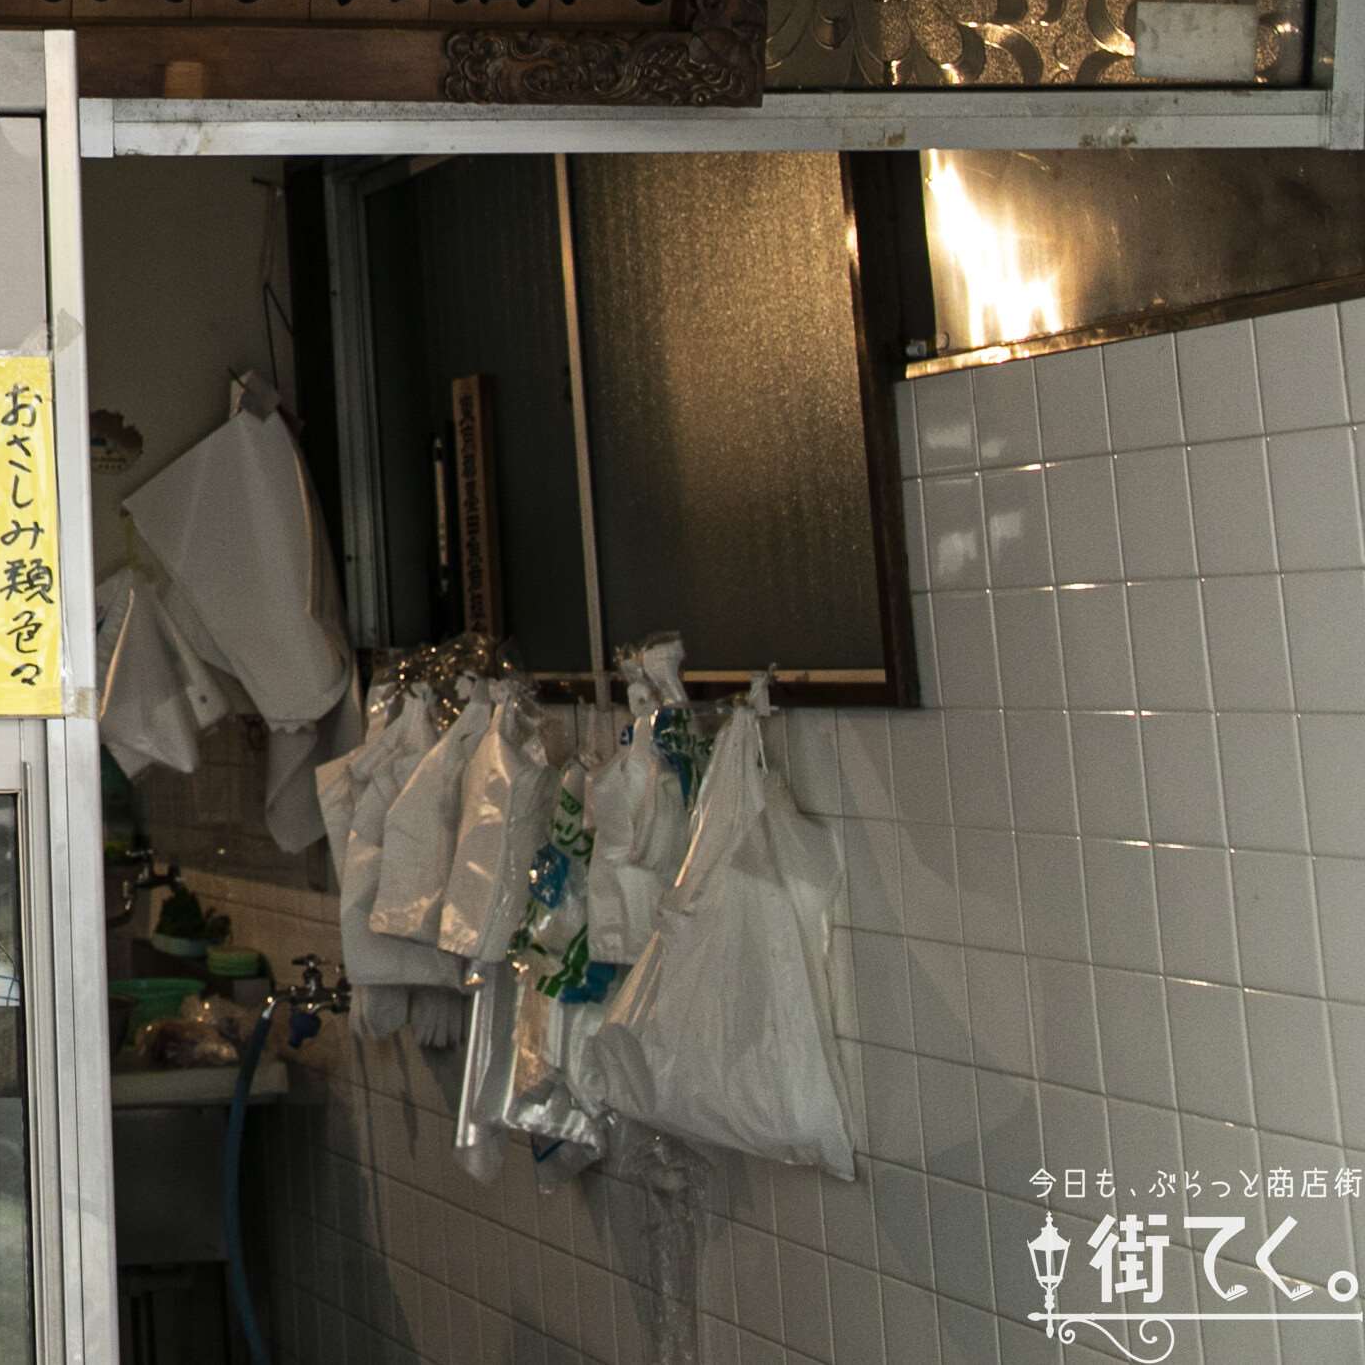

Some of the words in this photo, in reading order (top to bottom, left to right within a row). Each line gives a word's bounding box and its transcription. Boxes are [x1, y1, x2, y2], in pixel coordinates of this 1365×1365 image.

[0, 383, 55, 686] おさしみ類色々
